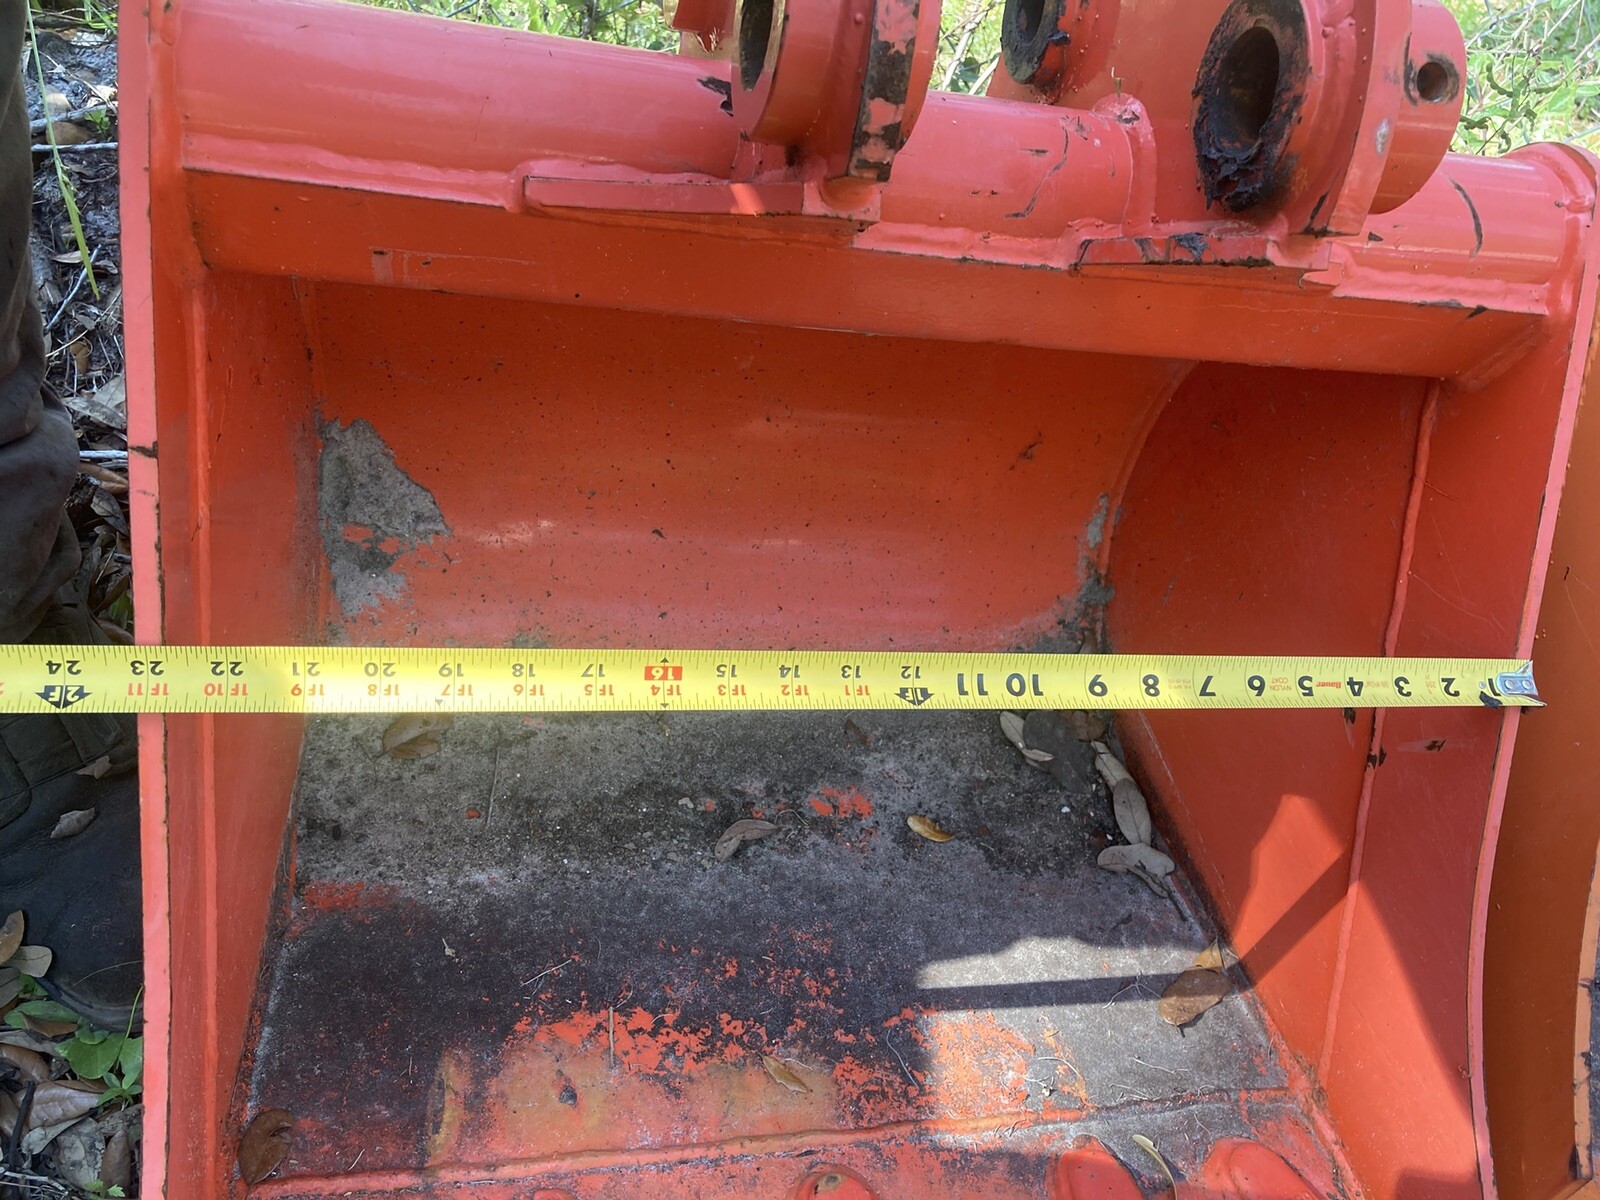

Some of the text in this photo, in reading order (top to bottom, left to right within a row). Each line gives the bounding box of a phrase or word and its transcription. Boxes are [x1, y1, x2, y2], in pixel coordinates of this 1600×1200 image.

[46, 660, 82, 676] 24
[130, 660, 165, 676] 23
[210, 661, 244, 677] 22
[292, 662, 321, 677] 21
[364, 662, 397, 678] 20
[438, 662, 464, 678] 19
[511, 663, 536, 678] 18
[581, 663, 605, 678] 17
[651, 666, 675, 680] 16
[716, 664, 737, 678] 15
[779, 664, 800, 679] 14
[841, 664, 861, 679] 13
[901, 665, 922, 680] 12
[957, 673, 988, 697] 11
[1005, 672, 1044, 697] 10
[1088, 674, 1108, 697] 9
[1142, 674, 1160, 697] 8
[1199, 675, 1217, 697] 7
[1247, 675, 1266, 697] 6
[1269, 684, 1292, 692] NYLON
[1298, 675, 1314, 697] 5
[1316, 681, 1341, 689] Bauer
[1346, 676, 1364, 697] 4
[1394, 676, 1412, 697] 3
[1441, 677, 1460, 697] 2
[48, 686, 80, 702] 2F
